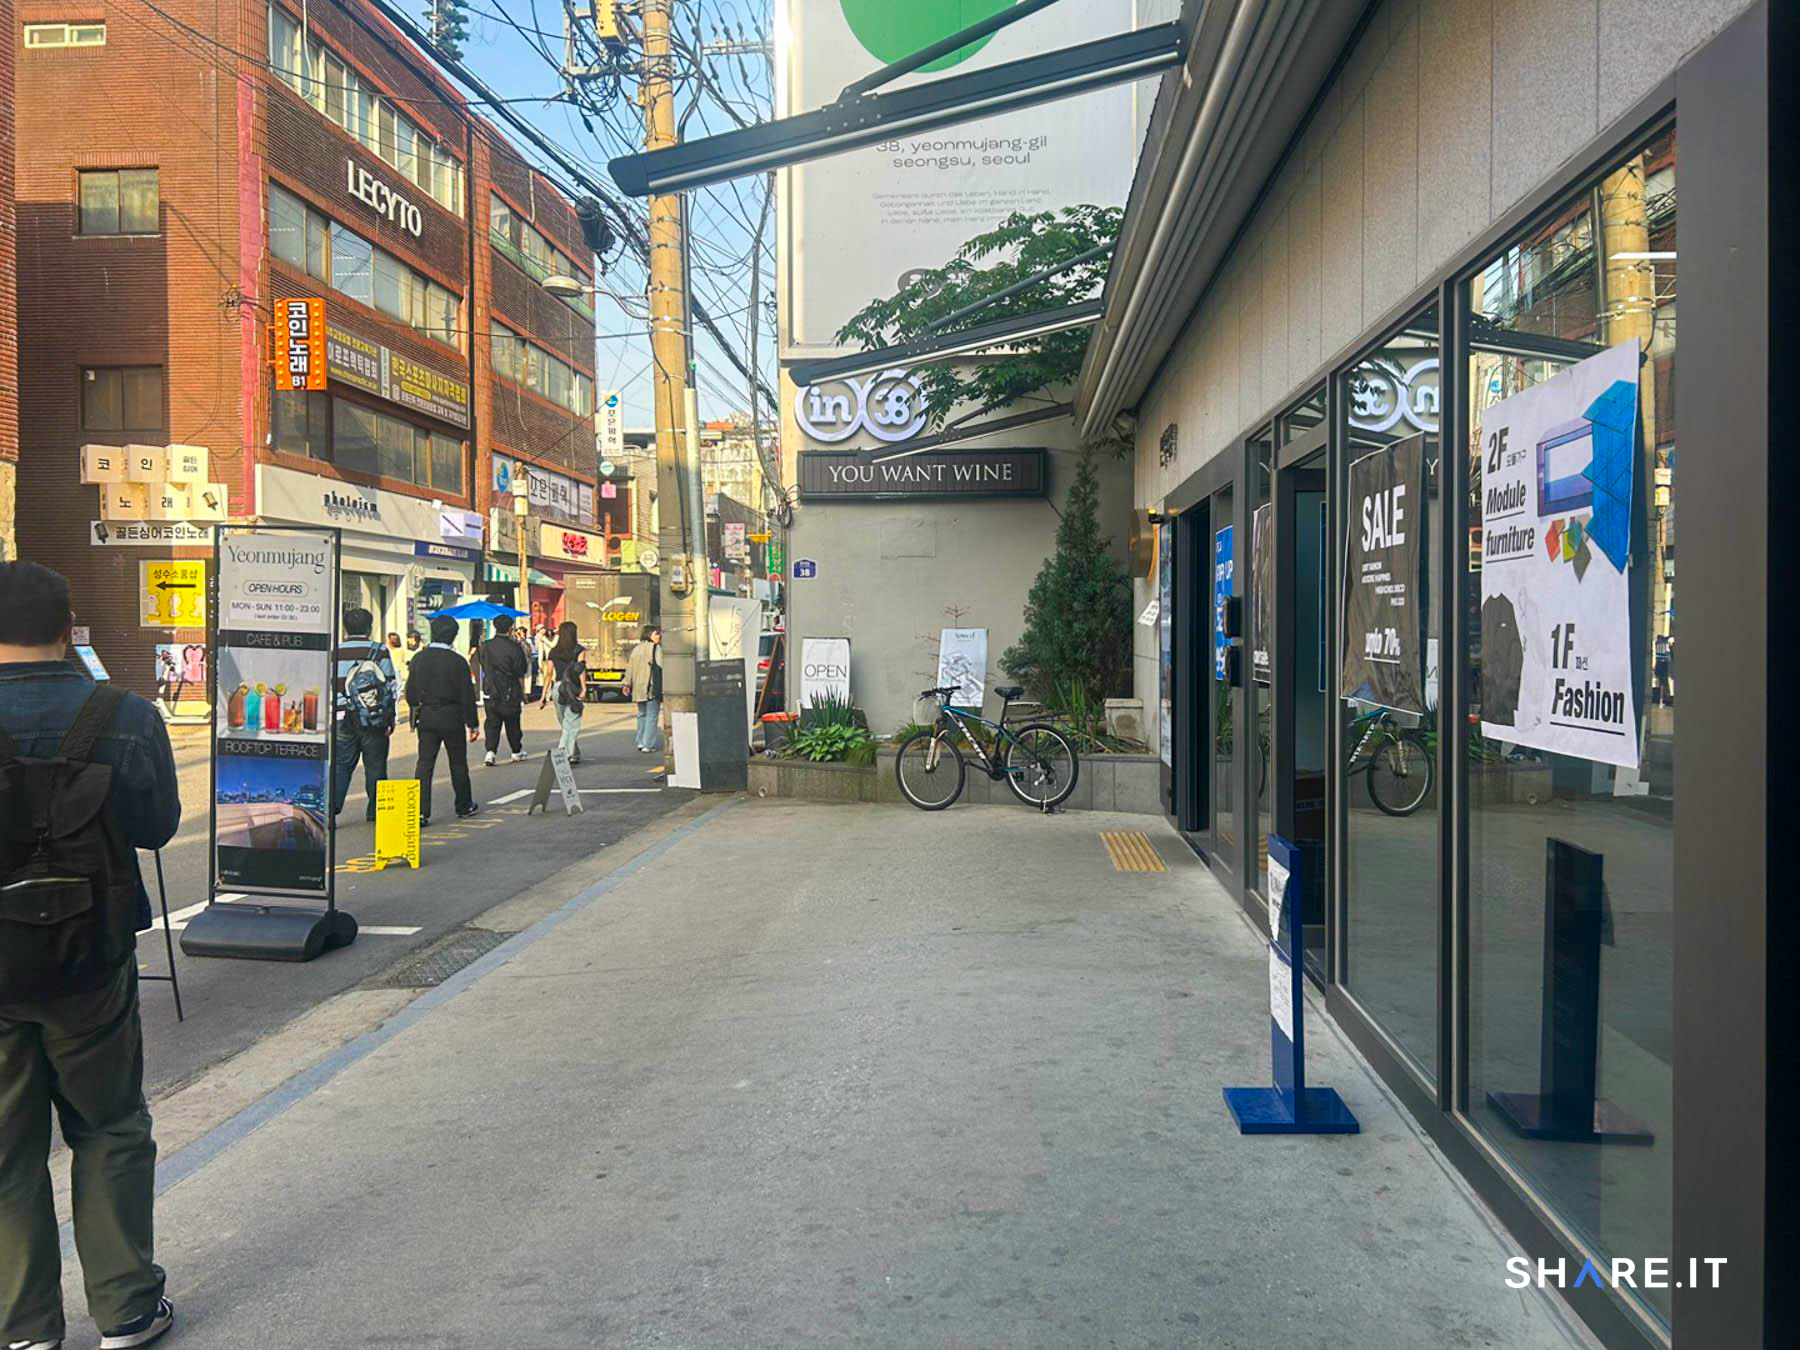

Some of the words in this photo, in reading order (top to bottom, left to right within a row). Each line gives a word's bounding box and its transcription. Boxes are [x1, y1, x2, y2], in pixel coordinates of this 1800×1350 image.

[911, 135, 1047, 155] yeonmujang-gil
[893, 155, 976, 170] seongsu,
[982, 152, 1031, 165] seoul
[347, 160, 422, 237] LECYTO
[288, 302, 308, 372] 코인노래
[808, 386, 853, 424] in
[876, 388, 910, 426] 38
[1487, 427, 1509, 475] 2F
[98, 458, 110, 470] 코
[140, 458, 152, 471] 인
[828, 465, 875, 482] YOU
[880, 465, 946, 482] WANT
[953, 464, 1012, 481] WINE
[119, 497, 131, 508] 노
[161, 497, 173, 508] 래
[1486, 480, 1526, 515] Module
[1361, 484, 1406, 552] SALE
[1486, 526, 1535, 557] furniture
[228, 545, 326, 575] Yeonmujang
[248, 583, 271, 593] OPEN
[272, 584, 303, 594] HOURS
[232, 602, 251, 610] MON
[256, 603, 272, 611] SUN
[601, 611, 640, 621] LOGEN
[246, 632, 273, 646] CAFE
[273, 635, 280, 647] &
[282, 635, 303, 647] PUB
[1551, 623, 1576, 669] 1F
[804, 663, 847, 678] OPEN
[1551, 678, 1625, 724] Fashion
[225, 740, 272, 755] ROOFTOP
[274, 744, 319, 757] TERRACE
